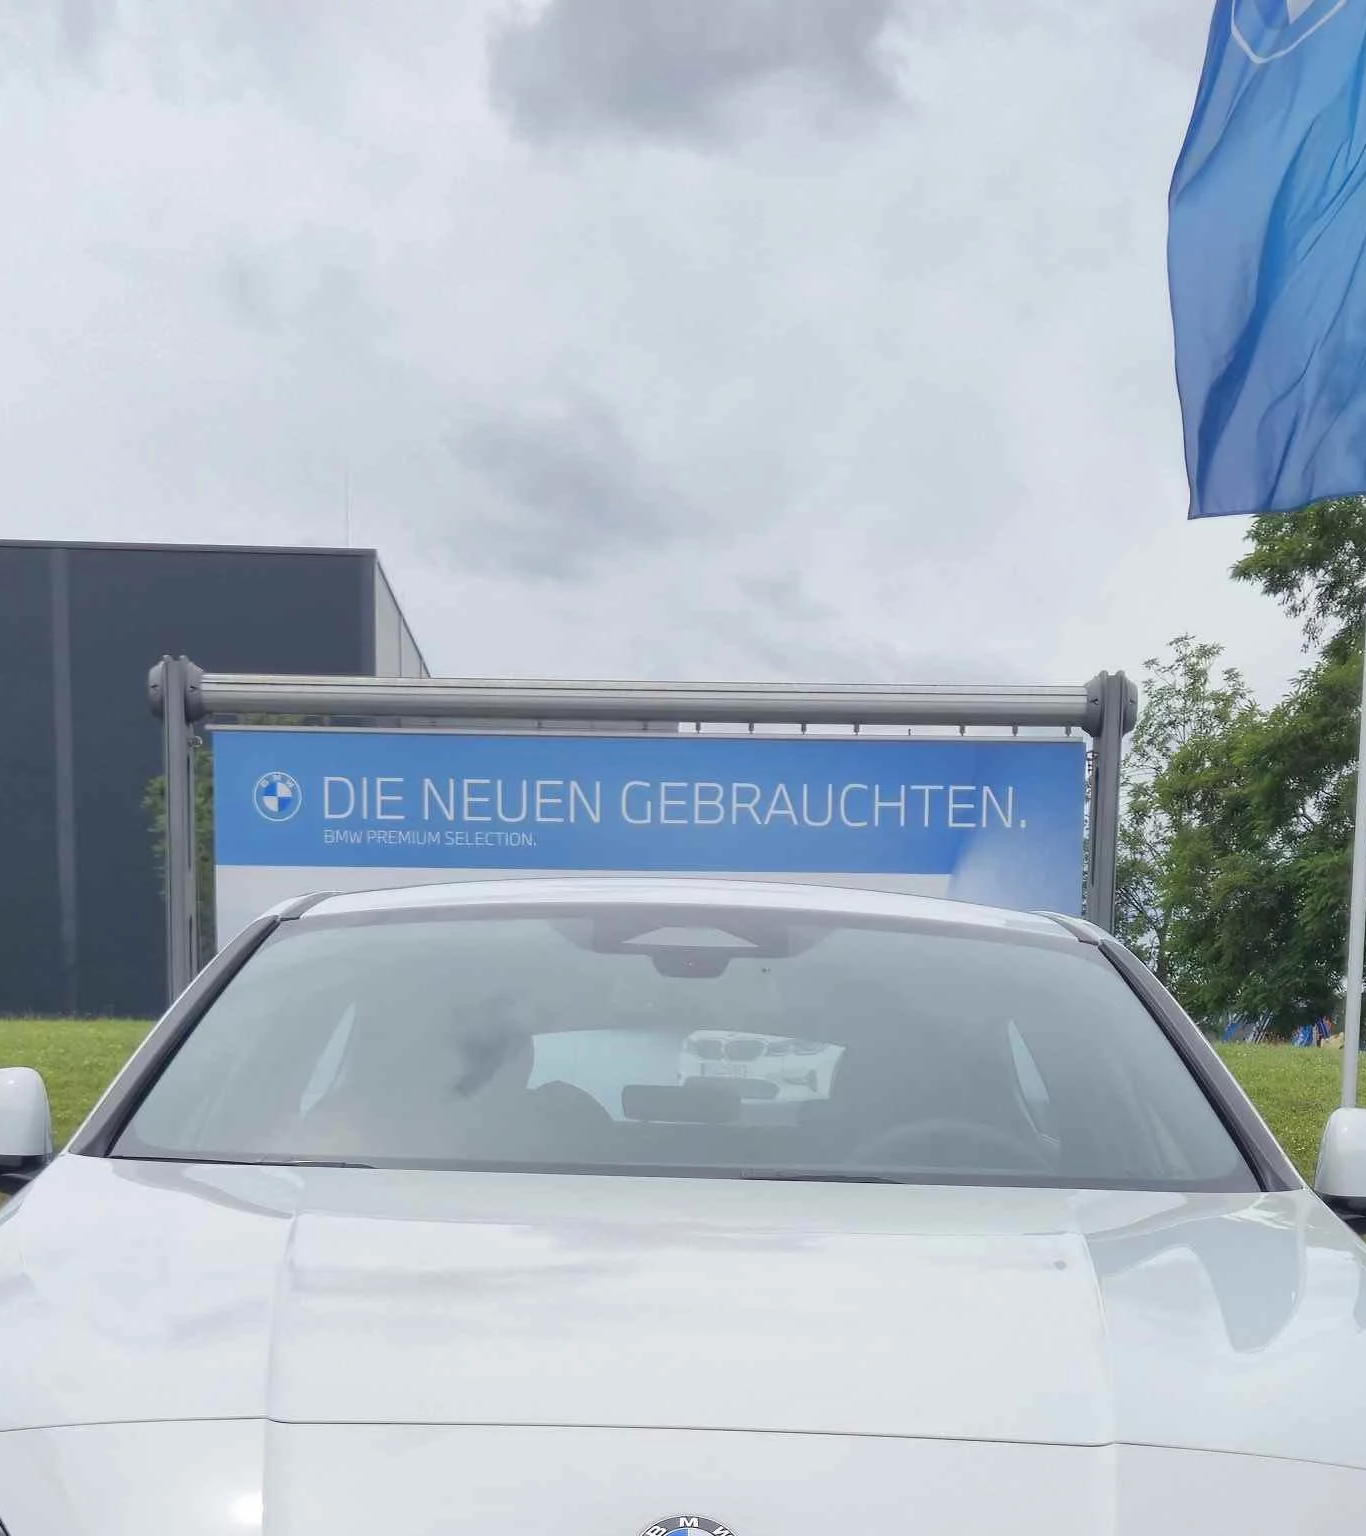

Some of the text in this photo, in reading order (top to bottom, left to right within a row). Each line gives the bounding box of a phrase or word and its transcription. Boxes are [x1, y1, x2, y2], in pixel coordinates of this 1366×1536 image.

[322, 775, 1027, 829] DIE NEUEN GEBRAUCHTEN.
[323, 828, 537, 848] BMW PREMIUM SELECTION.
